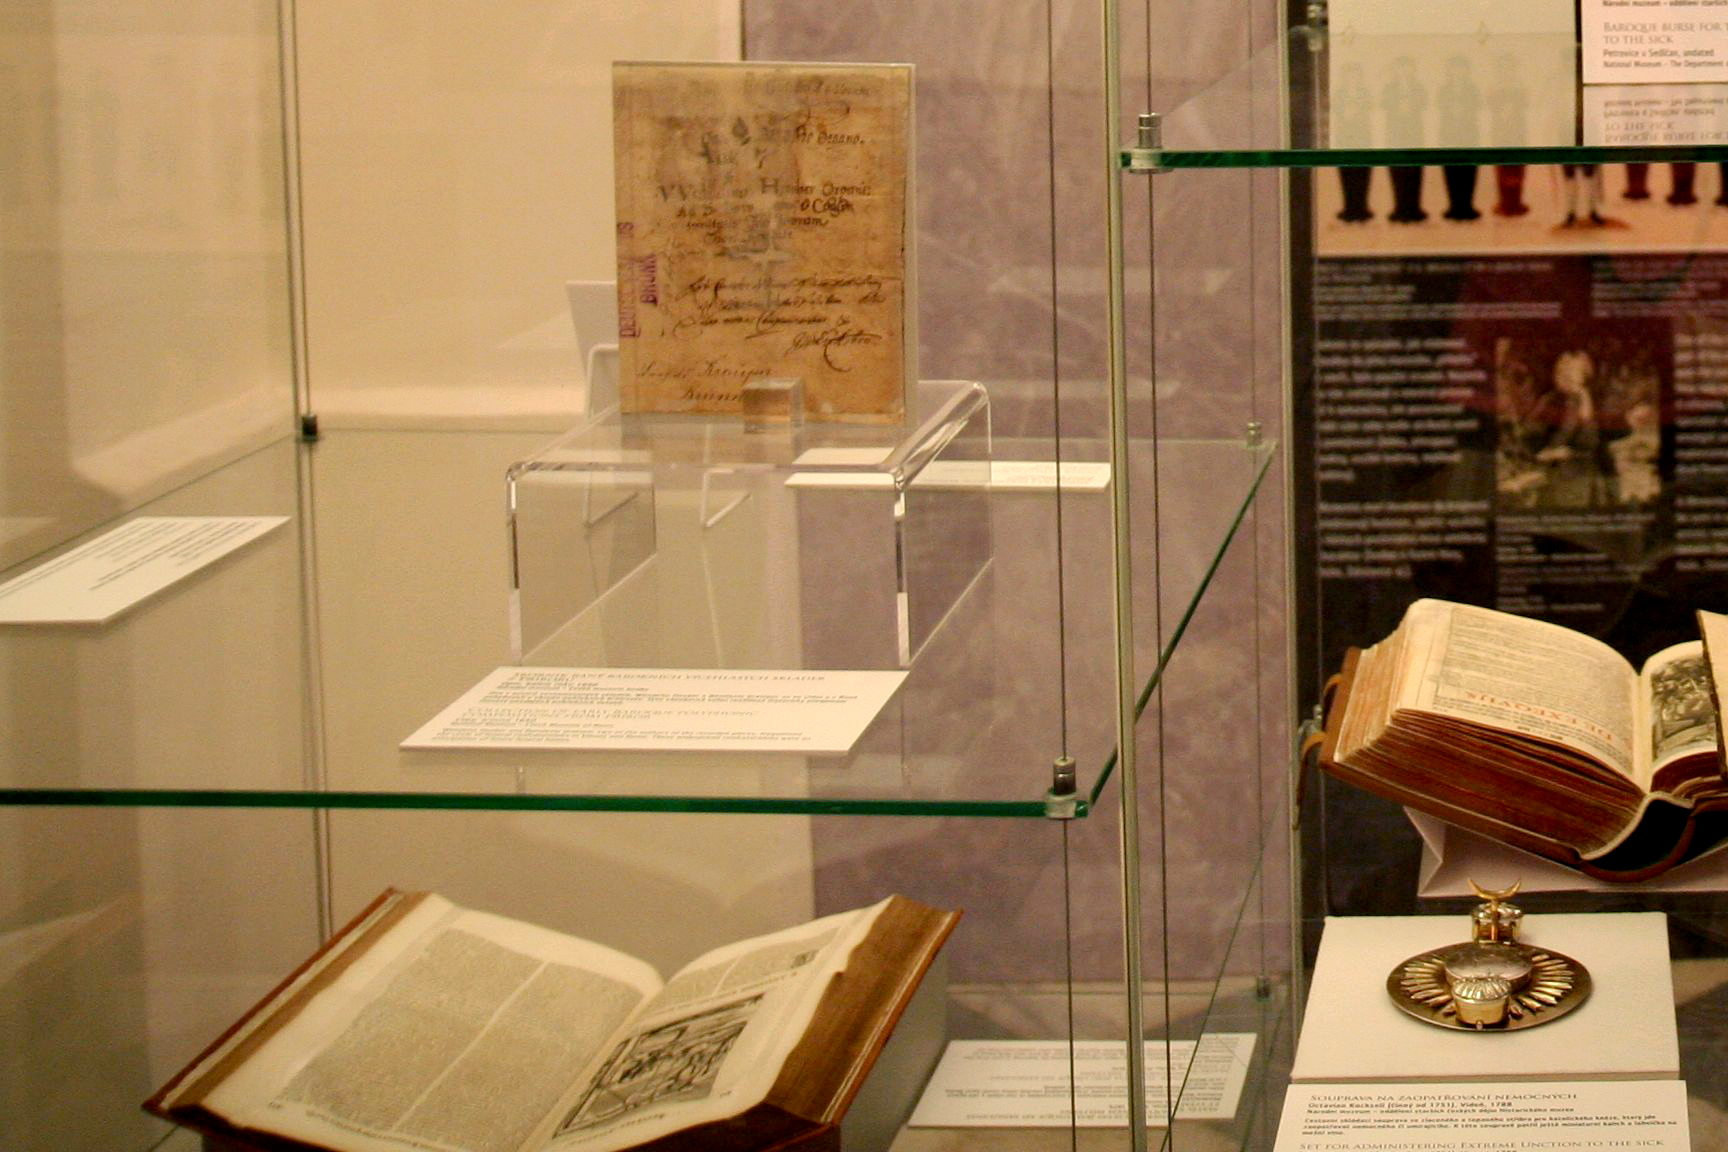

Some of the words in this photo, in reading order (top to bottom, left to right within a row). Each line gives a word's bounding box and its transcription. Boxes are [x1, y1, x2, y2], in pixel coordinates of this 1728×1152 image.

[1700, 22, 1722, 32] FOR
[1604, 35, 1620, 44] TO
[1623, 35, 1644, 44] THE
[1648, 35, 1674, 44] SICK
